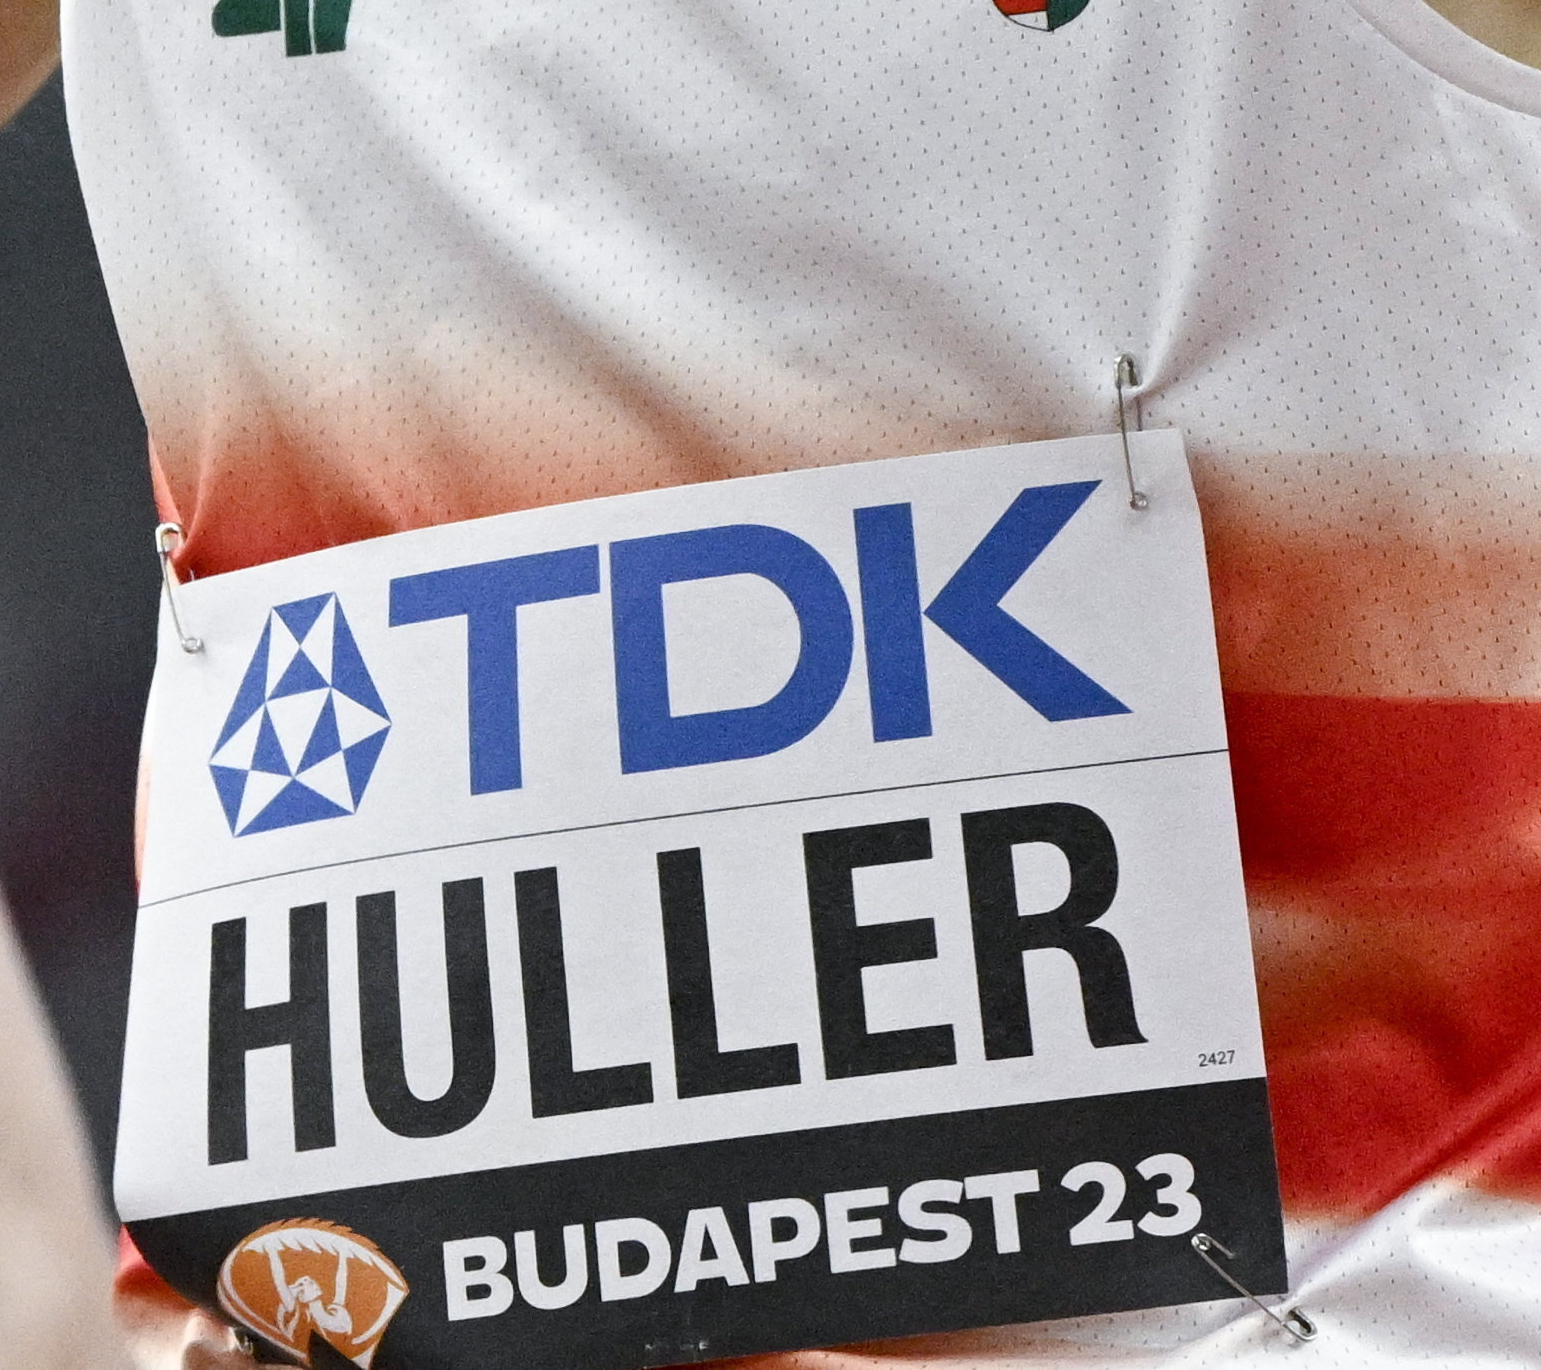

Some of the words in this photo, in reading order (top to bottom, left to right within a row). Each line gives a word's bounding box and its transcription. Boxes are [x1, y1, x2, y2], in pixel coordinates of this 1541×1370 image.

[388, 479, 1134, 796] TDK
[207, 801, 1148, 1165] HULLER
[1198, 1049, 1235, 1068] 2427
[442, 1169, 1041, 1321] BUDAPEST
[1060, 1152, 1203, 1248] 23
